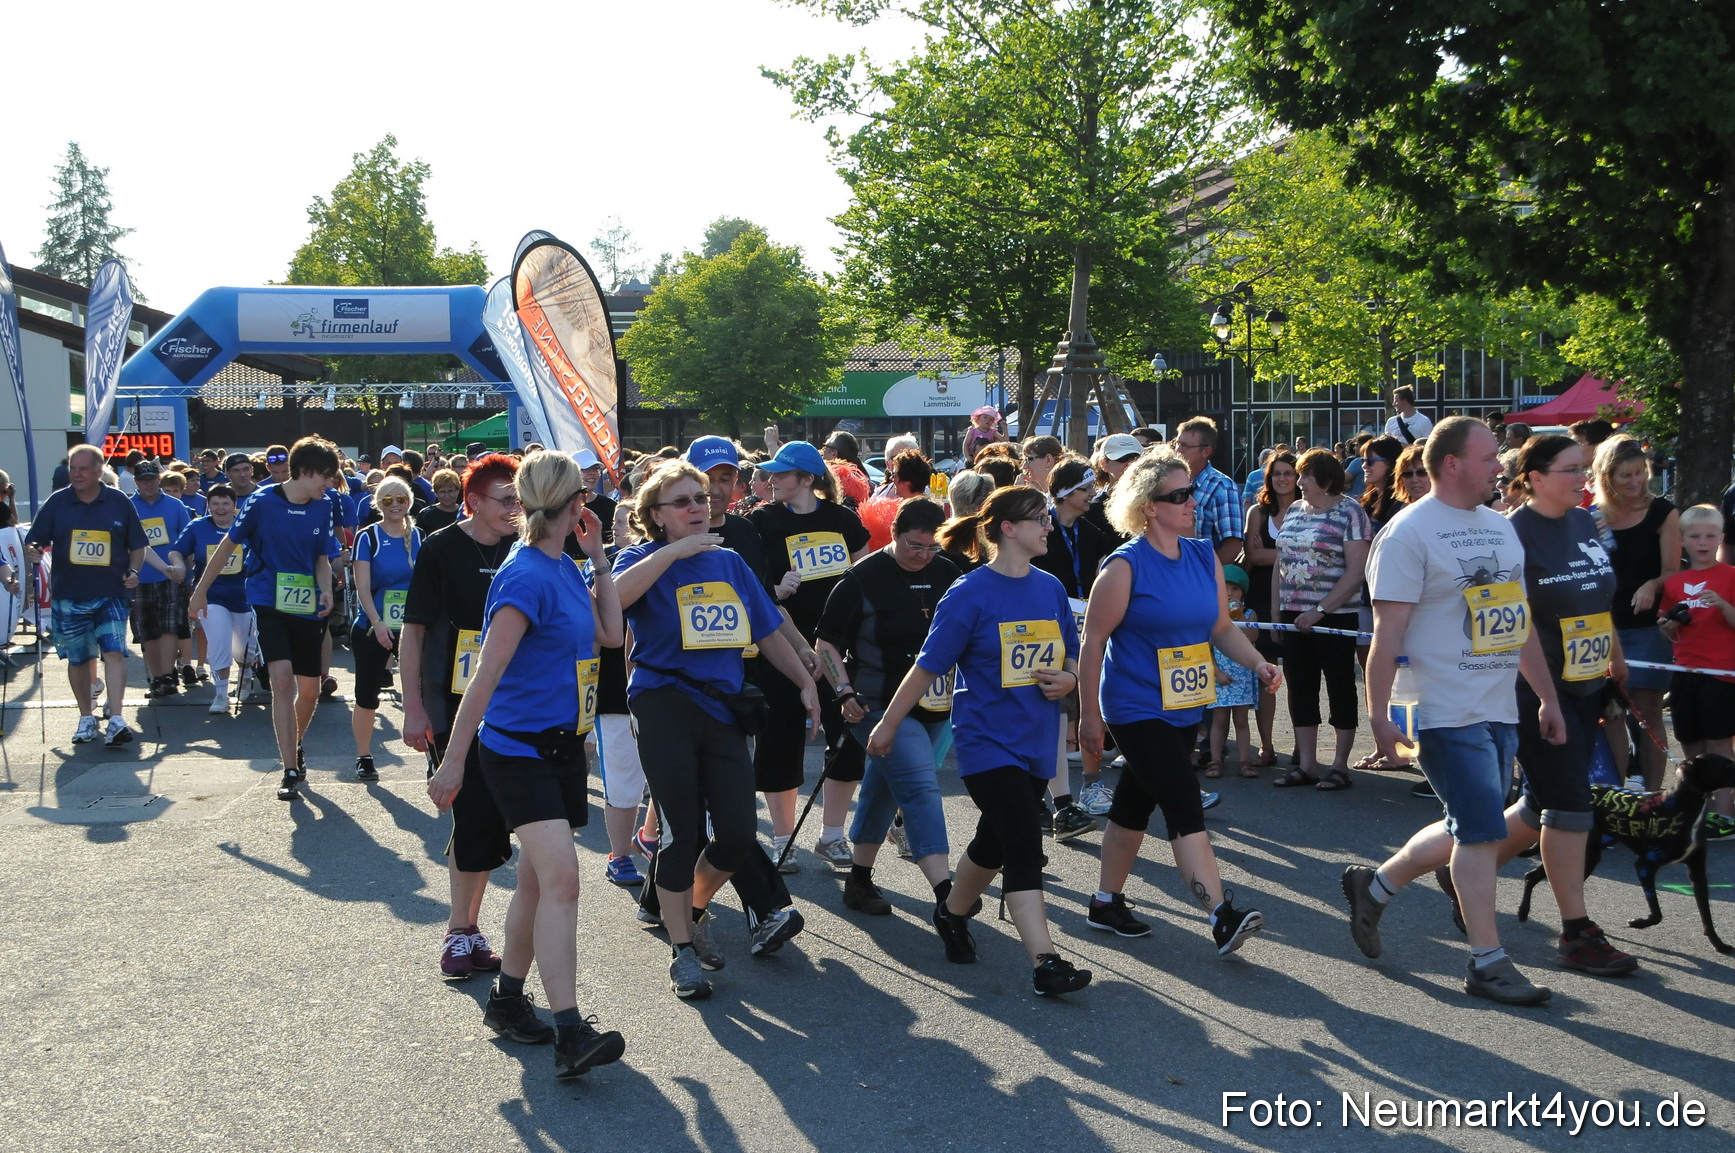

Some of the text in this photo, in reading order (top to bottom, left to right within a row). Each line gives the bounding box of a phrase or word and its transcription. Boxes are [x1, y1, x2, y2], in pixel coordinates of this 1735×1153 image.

[340, 304, 367, 312] Fischer
[321, 319, 399, 333] firmenlauf
[168, 343, 213, 354] Fischer
[923, 400, 961, 408] Lammsbräu
[1436, 529, 1467, 540] Service
[76, 541, 105, 557] 700
[791, 544, 847, 569] 1158
[1567, 559, 1589, 568] www.
[1580, 581, 1598, 591] .com
[283, 587, 312, 604] 712
[690, 604, 739, 632] 629
[1475, 603, 1526, 637] 1291
[1010, 642, 1055, 670] 674
[1567, 634, 1611, 665] 1290
[1170, 664, 1208, 693] 695
